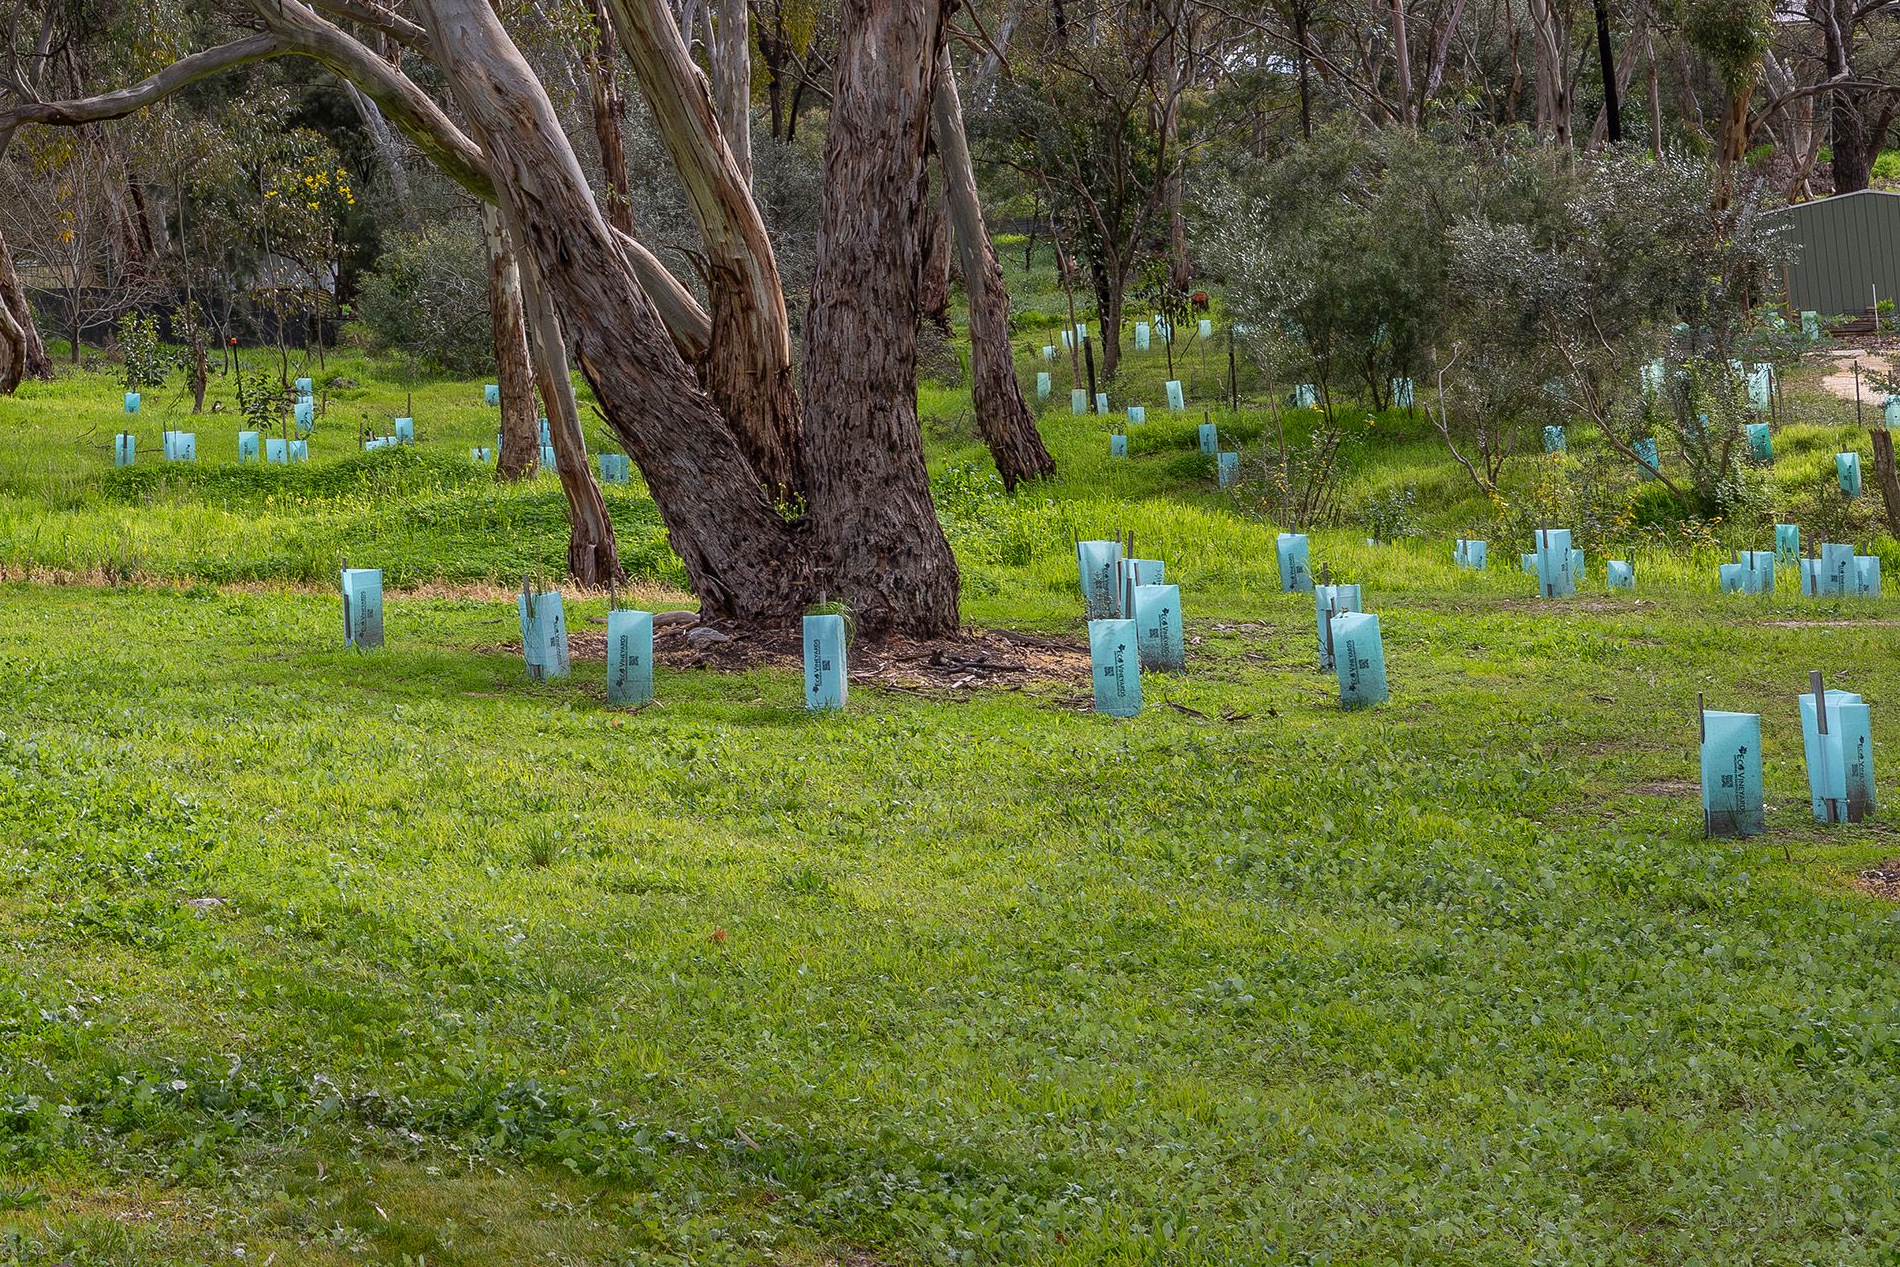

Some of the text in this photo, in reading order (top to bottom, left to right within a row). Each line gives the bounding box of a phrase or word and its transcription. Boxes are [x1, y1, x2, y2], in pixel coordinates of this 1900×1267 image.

[618, 635, 626, 667] VINEYARDS
[1346, 639, 1355, 672] VINEYARDS
[1118, 664, 1126, 697] VINEYARDS
[1738, 772, 1746, 814] VINEYARDS
